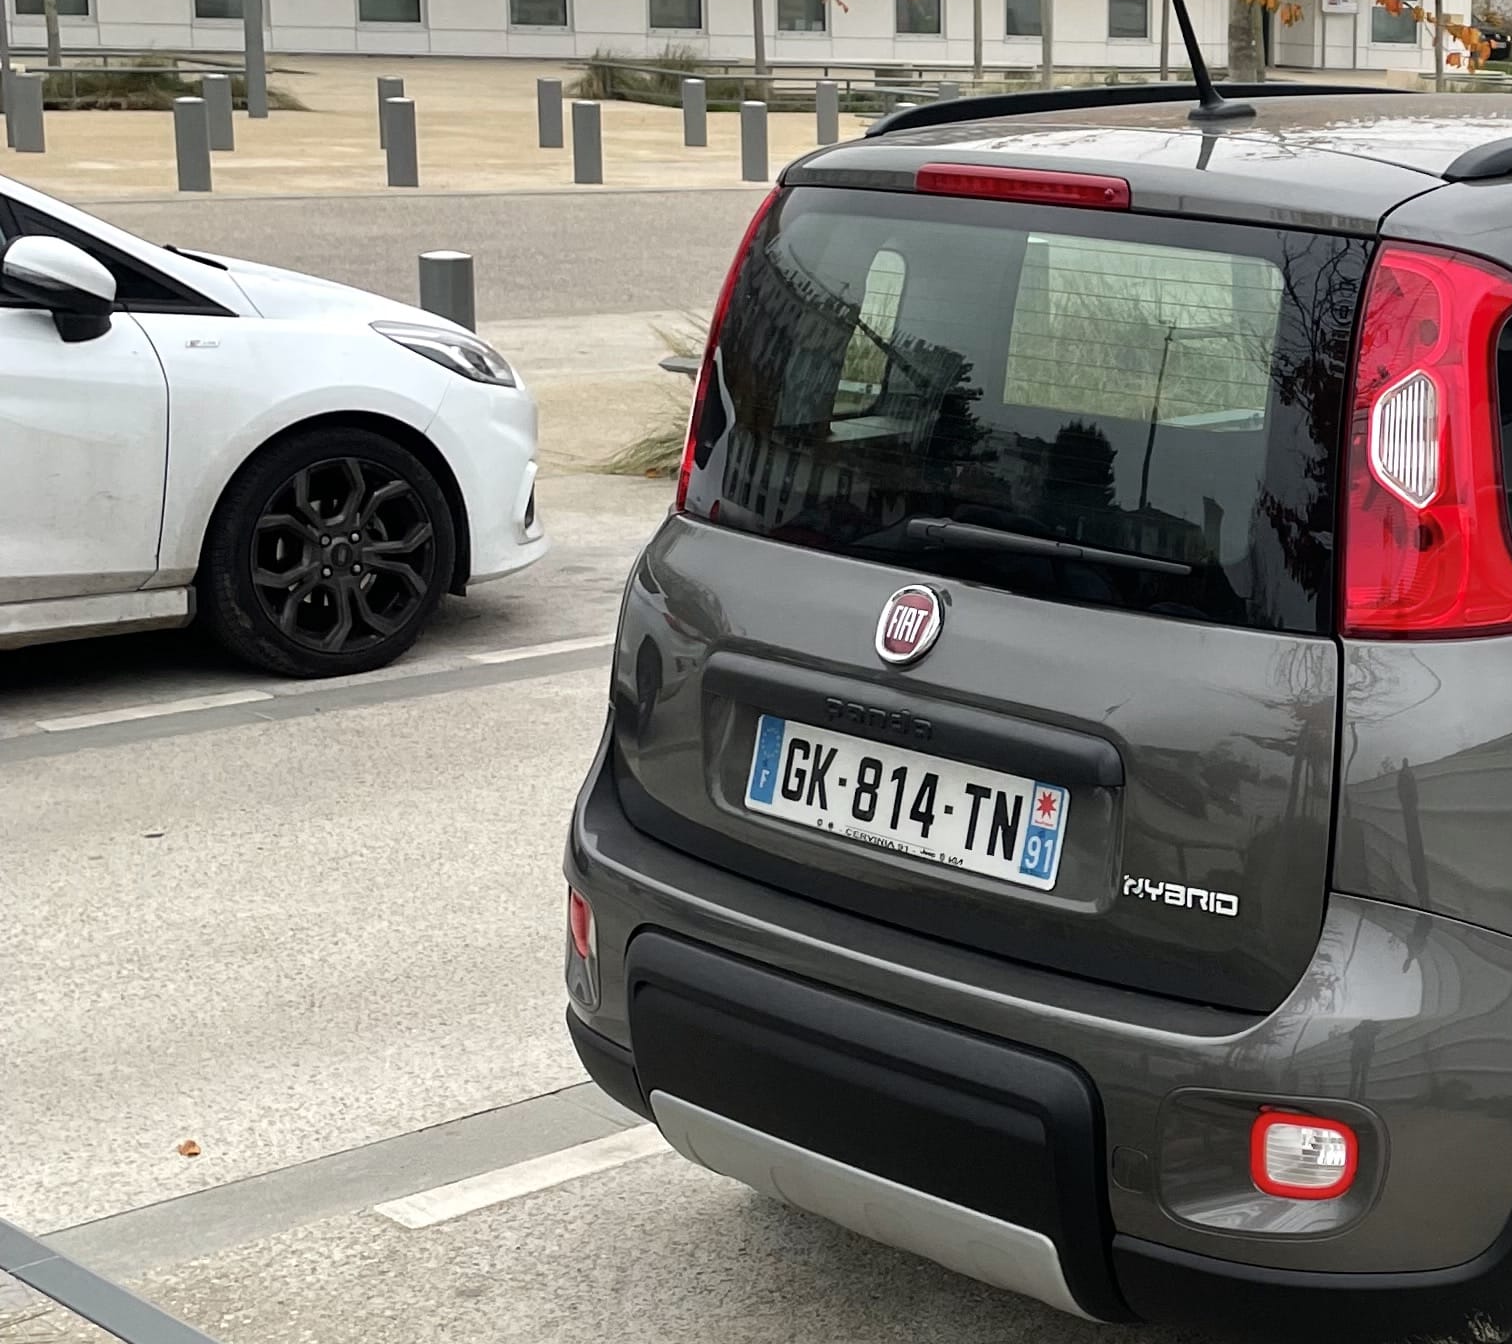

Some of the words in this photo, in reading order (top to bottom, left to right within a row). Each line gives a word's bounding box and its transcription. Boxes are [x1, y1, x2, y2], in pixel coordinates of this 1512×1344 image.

[886, 604, 929, 644] FIAT
[758, 768, 771, 789] F
[780, 737, 1024, 861] GK-814-TN
[1024, 835, 1054, 873] 91
[1122, 874, 1239, 917] HYBRID
